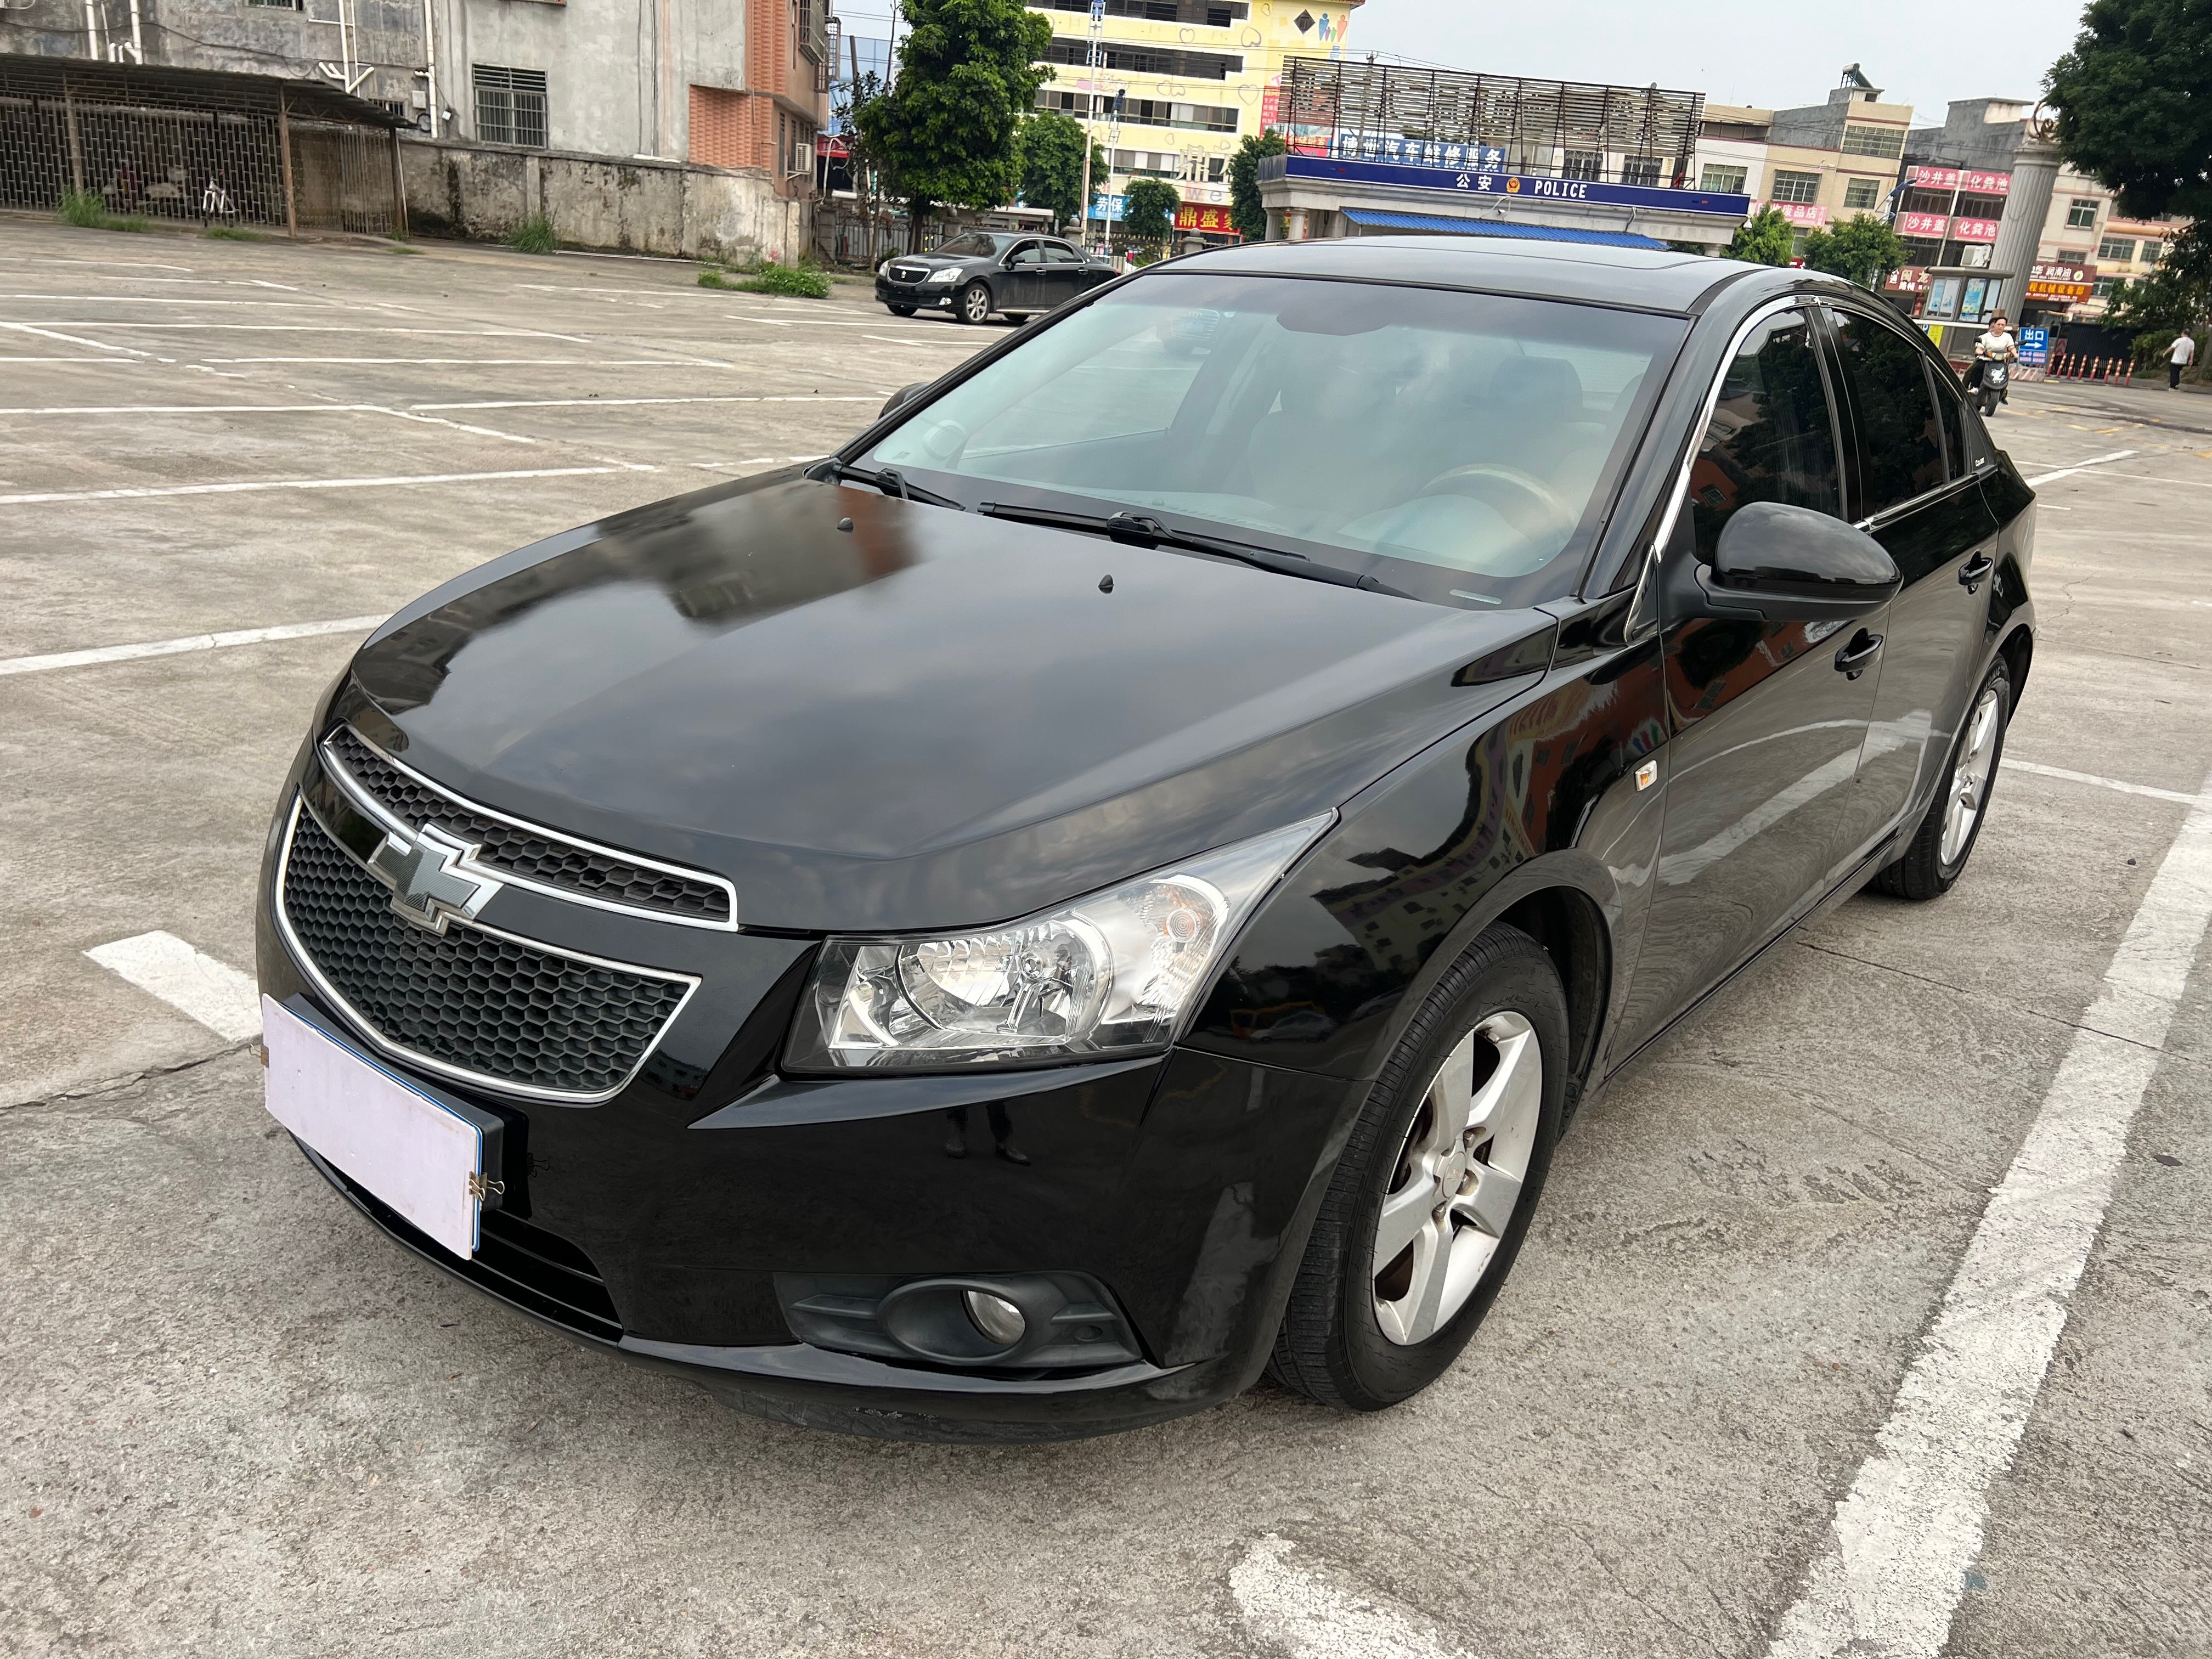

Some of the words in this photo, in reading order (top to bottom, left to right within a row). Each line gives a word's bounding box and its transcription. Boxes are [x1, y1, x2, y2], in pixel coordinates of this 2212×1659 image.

[1342, 136, 1502, 170] 博世汽车维修服务
[1918, 170, 1957, 185] 沙井盖
[1970, 174, 2008, 191] 化粪池
[1456, 173, 1492, 191] 公安
[1534, 179, 1588, 199] POLICE
[1096, 196, 1124, 212] 劳保
[1907, 216, 1946, 232] 沙井盖
[1959, 221, 1997, 238] 化粪池
[2045, 266, 2072, 278] 润滑油
[2024, 329, 2044, 341] 出口
